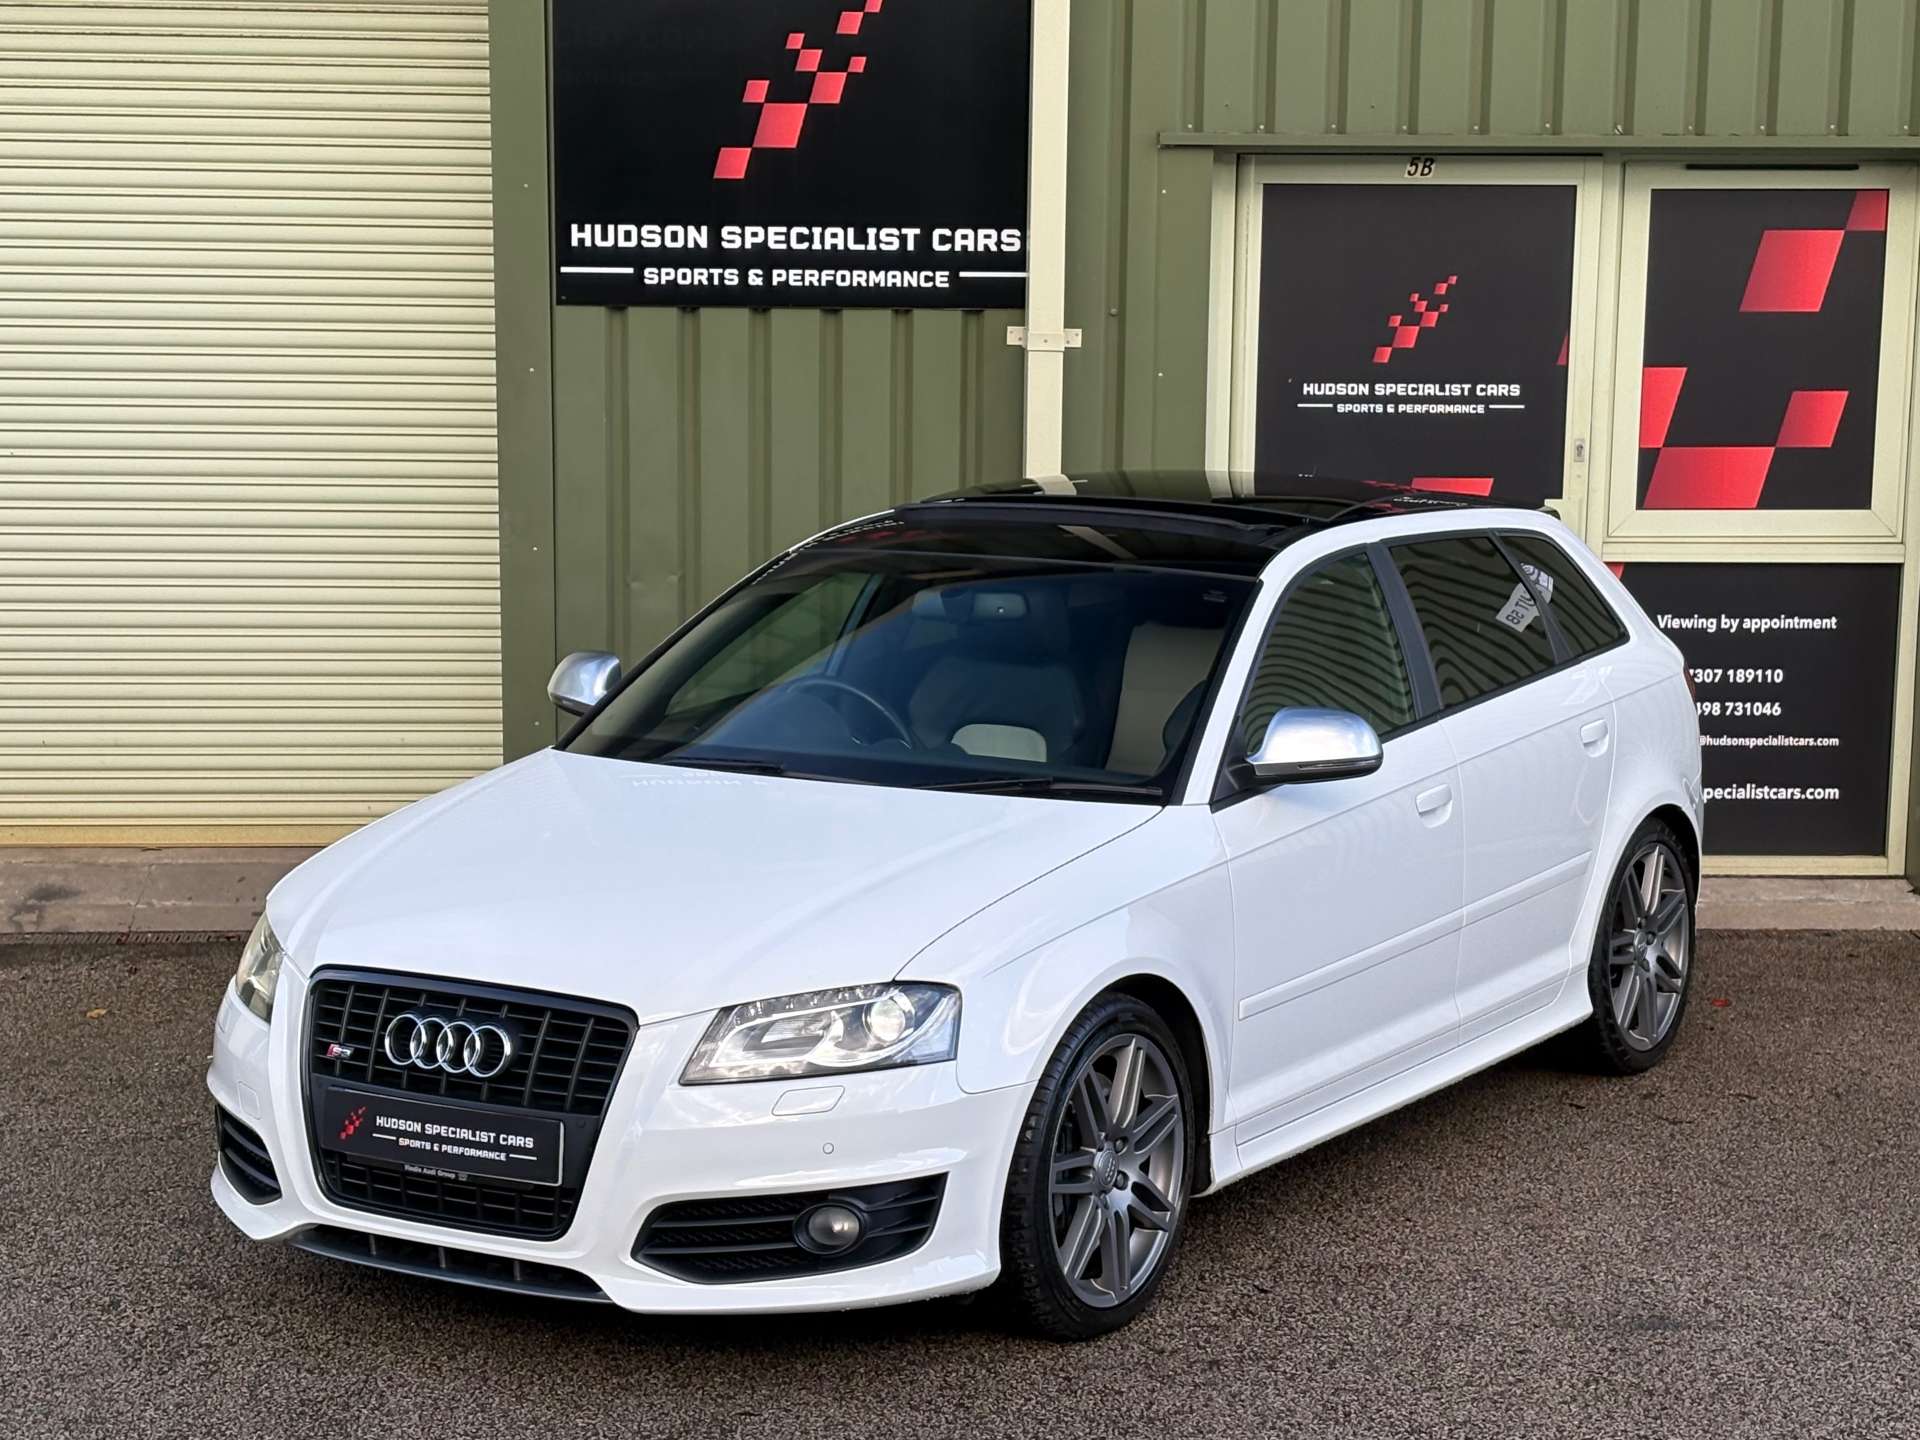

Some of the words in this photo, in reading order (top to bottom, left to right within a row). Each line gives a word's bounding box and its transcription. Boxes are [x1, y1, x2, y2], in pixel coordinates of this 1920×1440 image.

[1407, 156, 1435, 176] 5B
[570, 223, 708, 249] HUDSON
[720, 226, 921, 252] SPECIALIST
[932, 229, 1022, 252] CARS
[643, 267, 740, 286] SPORTS
[747, 268, 764, 286] &
[773, 269, 950, 288] PERFORMANCE
[1303, 382, 1370, 396] HUDSON
[1374, 383, 1472, 397] SPECIALIST
[1475, 383, 1521, 397] CARS
[1336, 403, 1383, 414] SPORTS
[1386, 403, 1395, 414] &
[1398, 404, 1486, 414] PERFORMANCE
[1657, 614, 1717, 633] Viewing
[1720, 614, 1740, 633] by
[1742, 615, 1838, 633] appointment
[1726, 668, 1784, 684] 189110
[1725, 702, 1782, 717] 731046
[376, 1115, 422, 1134] HUDSON
[424, 1123, 496, 1144] SPECIALIST
[499, 1134, 534, 1149] CARS
[398, 1137, 431, 1150] SPORTS
[441, 1144, 507, 1161] PERFORMANCE
[423, 1167, 436, 1176] Audi
[437, 1169, 456, 1180] Group
